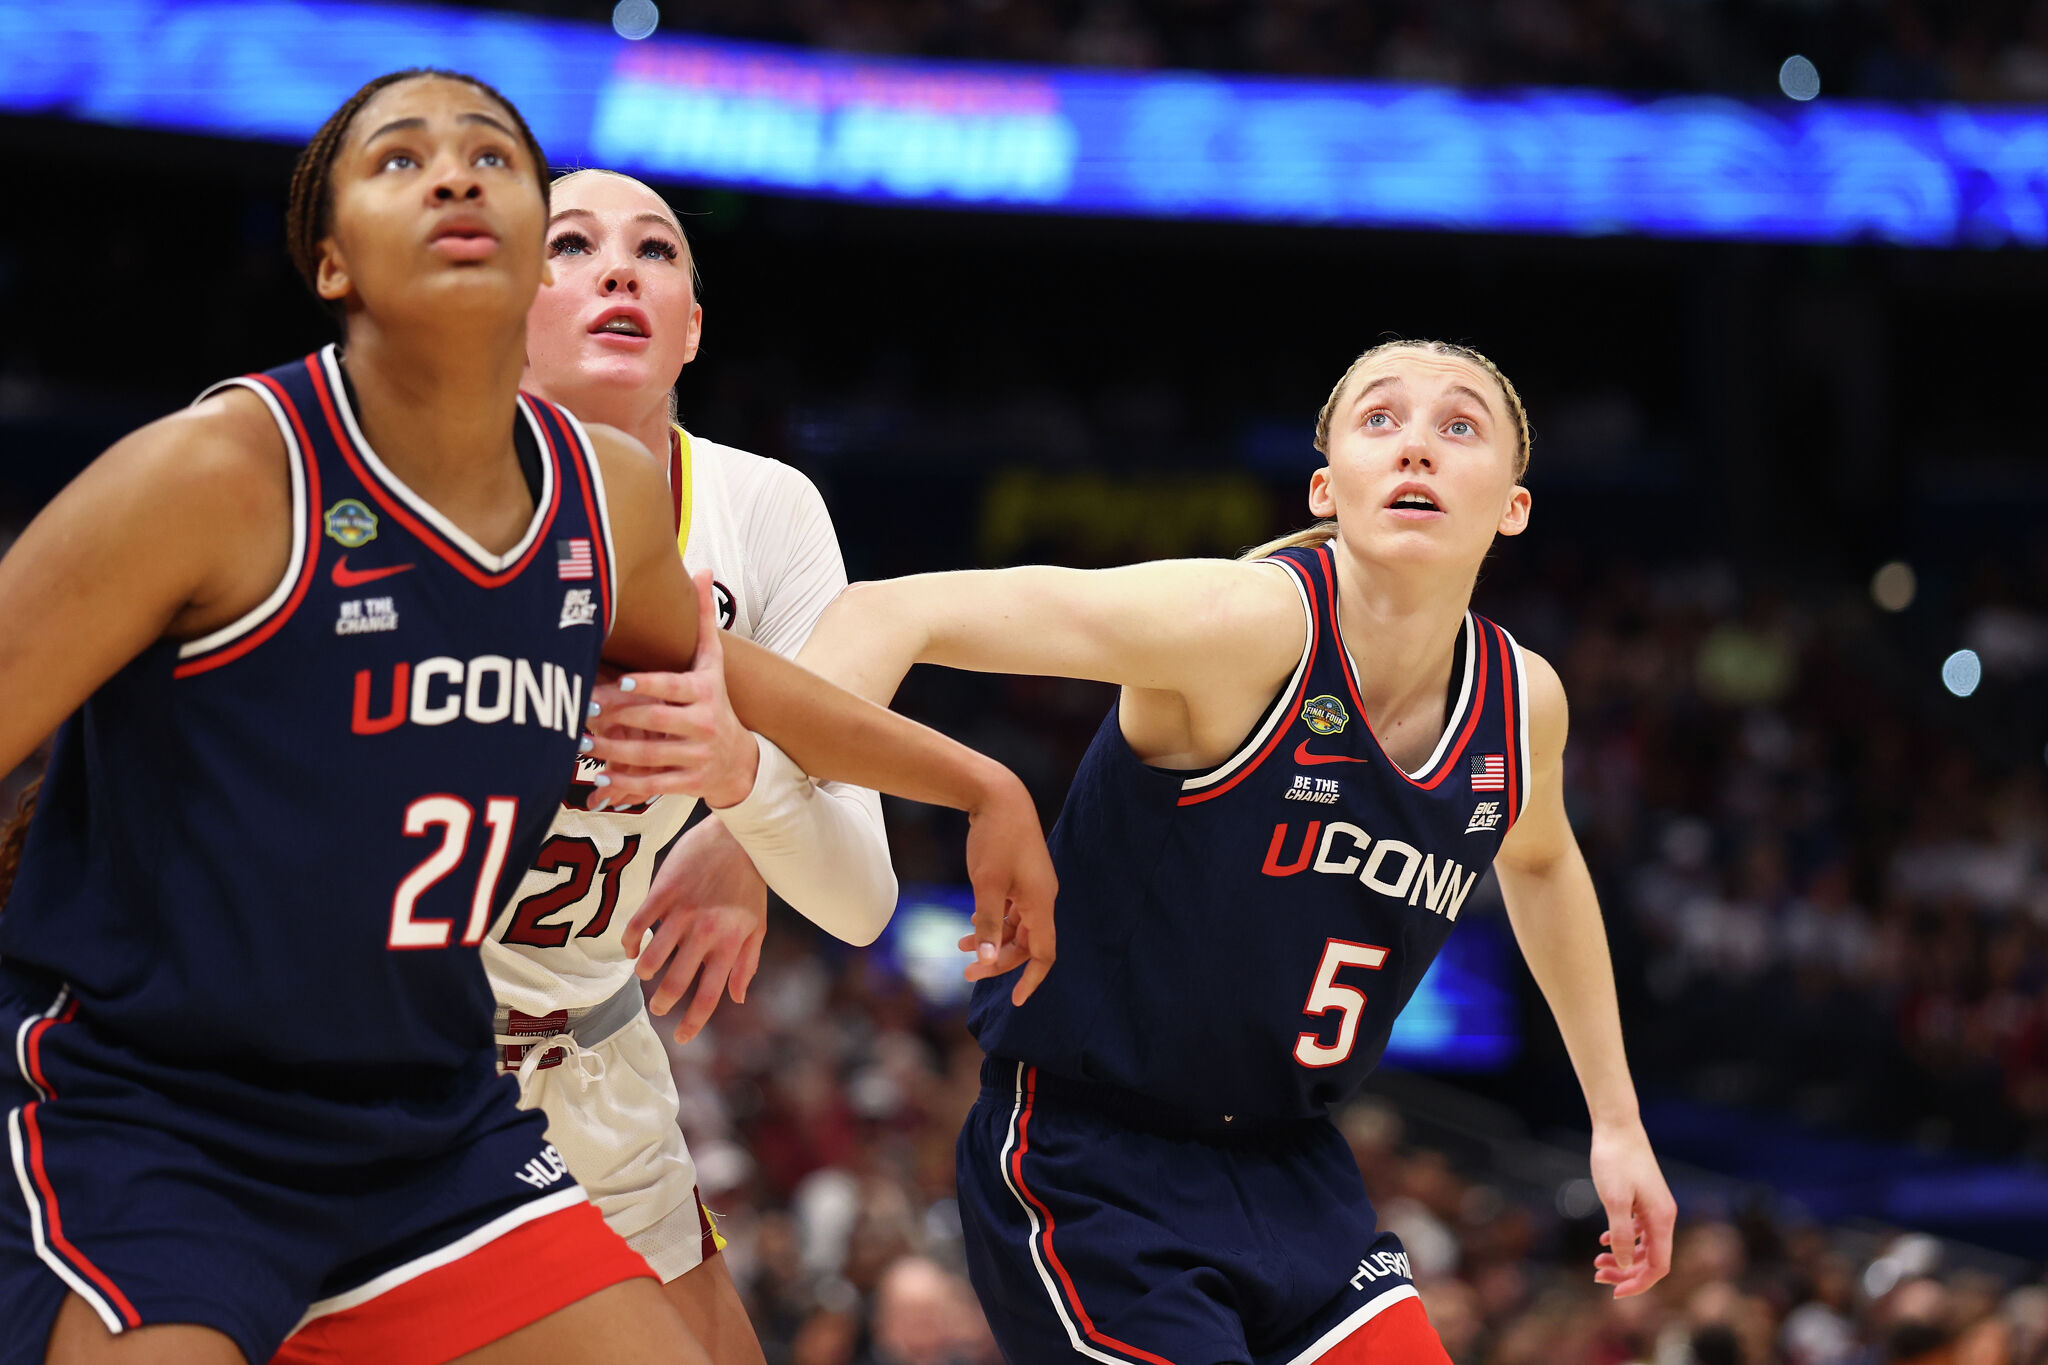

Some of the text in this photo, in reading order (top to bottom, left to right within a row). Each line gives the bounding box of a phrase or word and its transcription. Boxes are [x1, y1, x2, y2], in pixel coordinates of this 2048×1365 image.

[340, 596, 394, 619] BE THE
[335, 613, 399, 636] CHANGE
[351, 654, 582, 740] UCONN
[1306, 706, 1344, 727] FINAL FOUR
[1293, 775, 1339, 793] BE THE
[1284, 788, 1340, 804] CHANGE
[1473, 801, 1500, 815] BIG
[1468, 813, 1503, 827] EAST
[386, 792, 519, 950] 21
[1261, 821, 1477, 922] UCONN
[499, 834, 641, 948] 21
[1292, 937, 1391, 1068] 5
